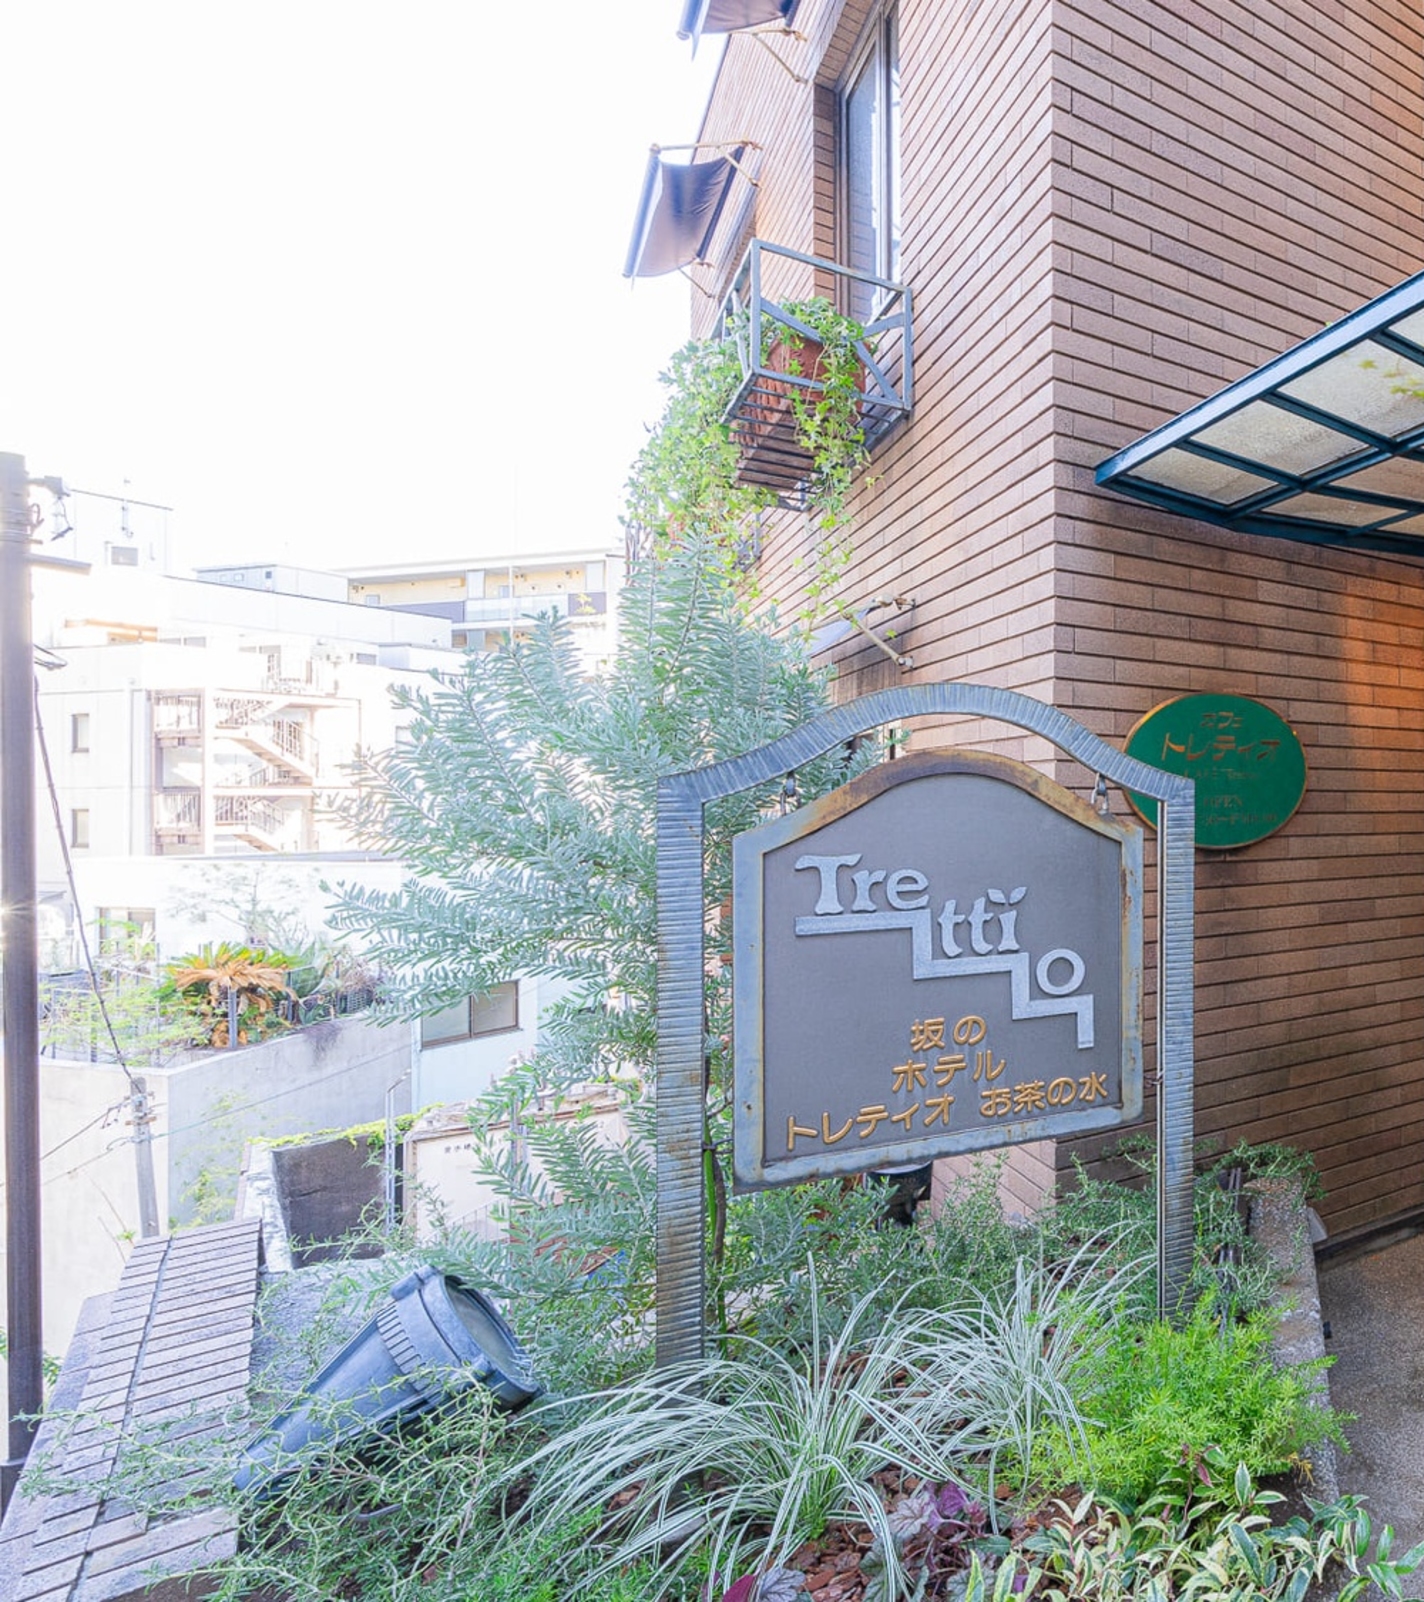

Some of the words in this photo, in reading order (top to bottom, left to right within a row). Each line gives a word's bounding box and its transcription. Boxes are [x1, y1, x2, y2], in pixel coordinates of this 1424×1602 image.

[1161, 732, 1280, 761] トレティオ
[910, 1015, 987, 1052] 坂の
[891, 1049, 1006, 1093] ホテル
[786, 1093, 955, 1151] トレティオ
[978, 1072, 1109, 1118] お茶の水
